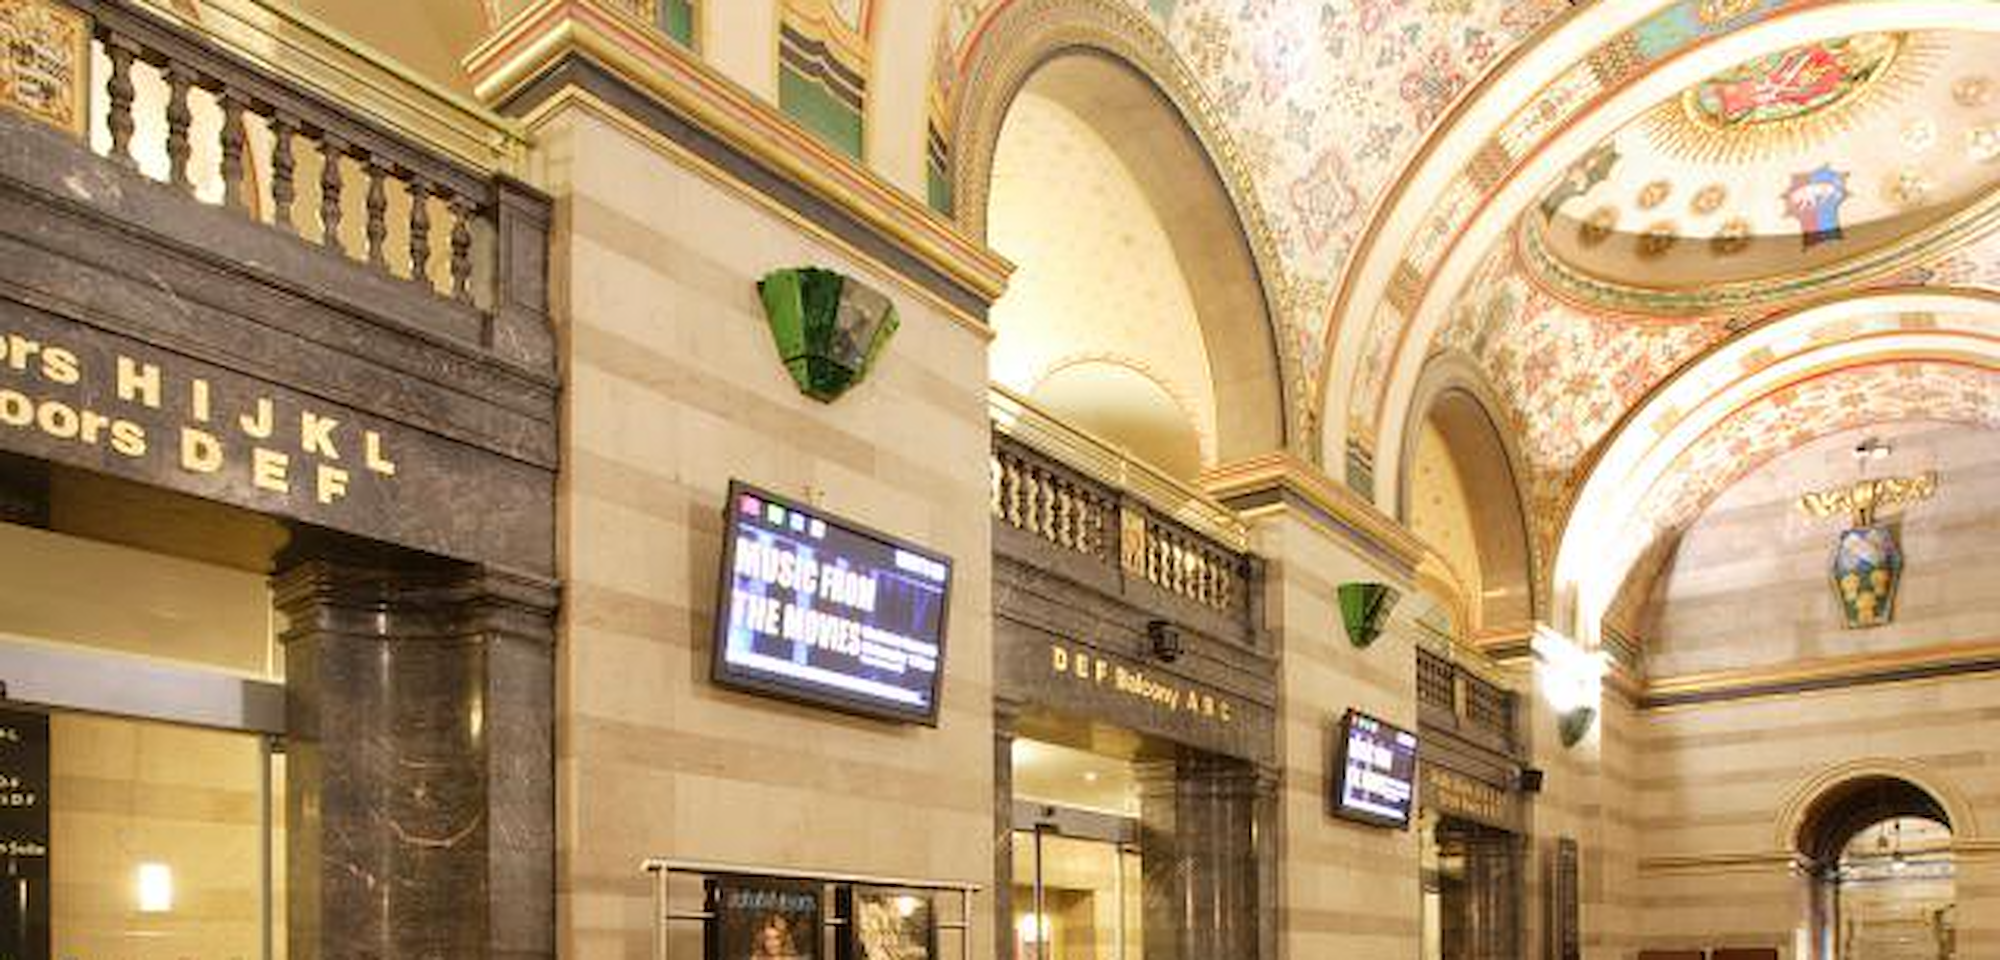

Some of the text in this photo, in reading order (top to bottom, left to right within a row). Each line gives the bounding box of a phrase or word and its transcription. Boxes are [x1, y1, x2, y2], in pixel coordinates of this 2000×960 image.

[117, 354, 161, 408] H
[193, 379, 209, 422] I
[240, 398, 273, 438] J
[302, 410, 340, 459] K
[364, 430, 395, 475] L
[180, 426, 223, 472] D
[253, 447, 288, 493] E
[317, 464, 348, 504] F
[735, 536, 818, 593] MUSIC
[820, 562, 876, 612] FROM
[731, 587, 781, 636] THE
[783, 602, 861, 657] MOVIES
[1053, 646, 1231, 721] D E F Balcony A B C
